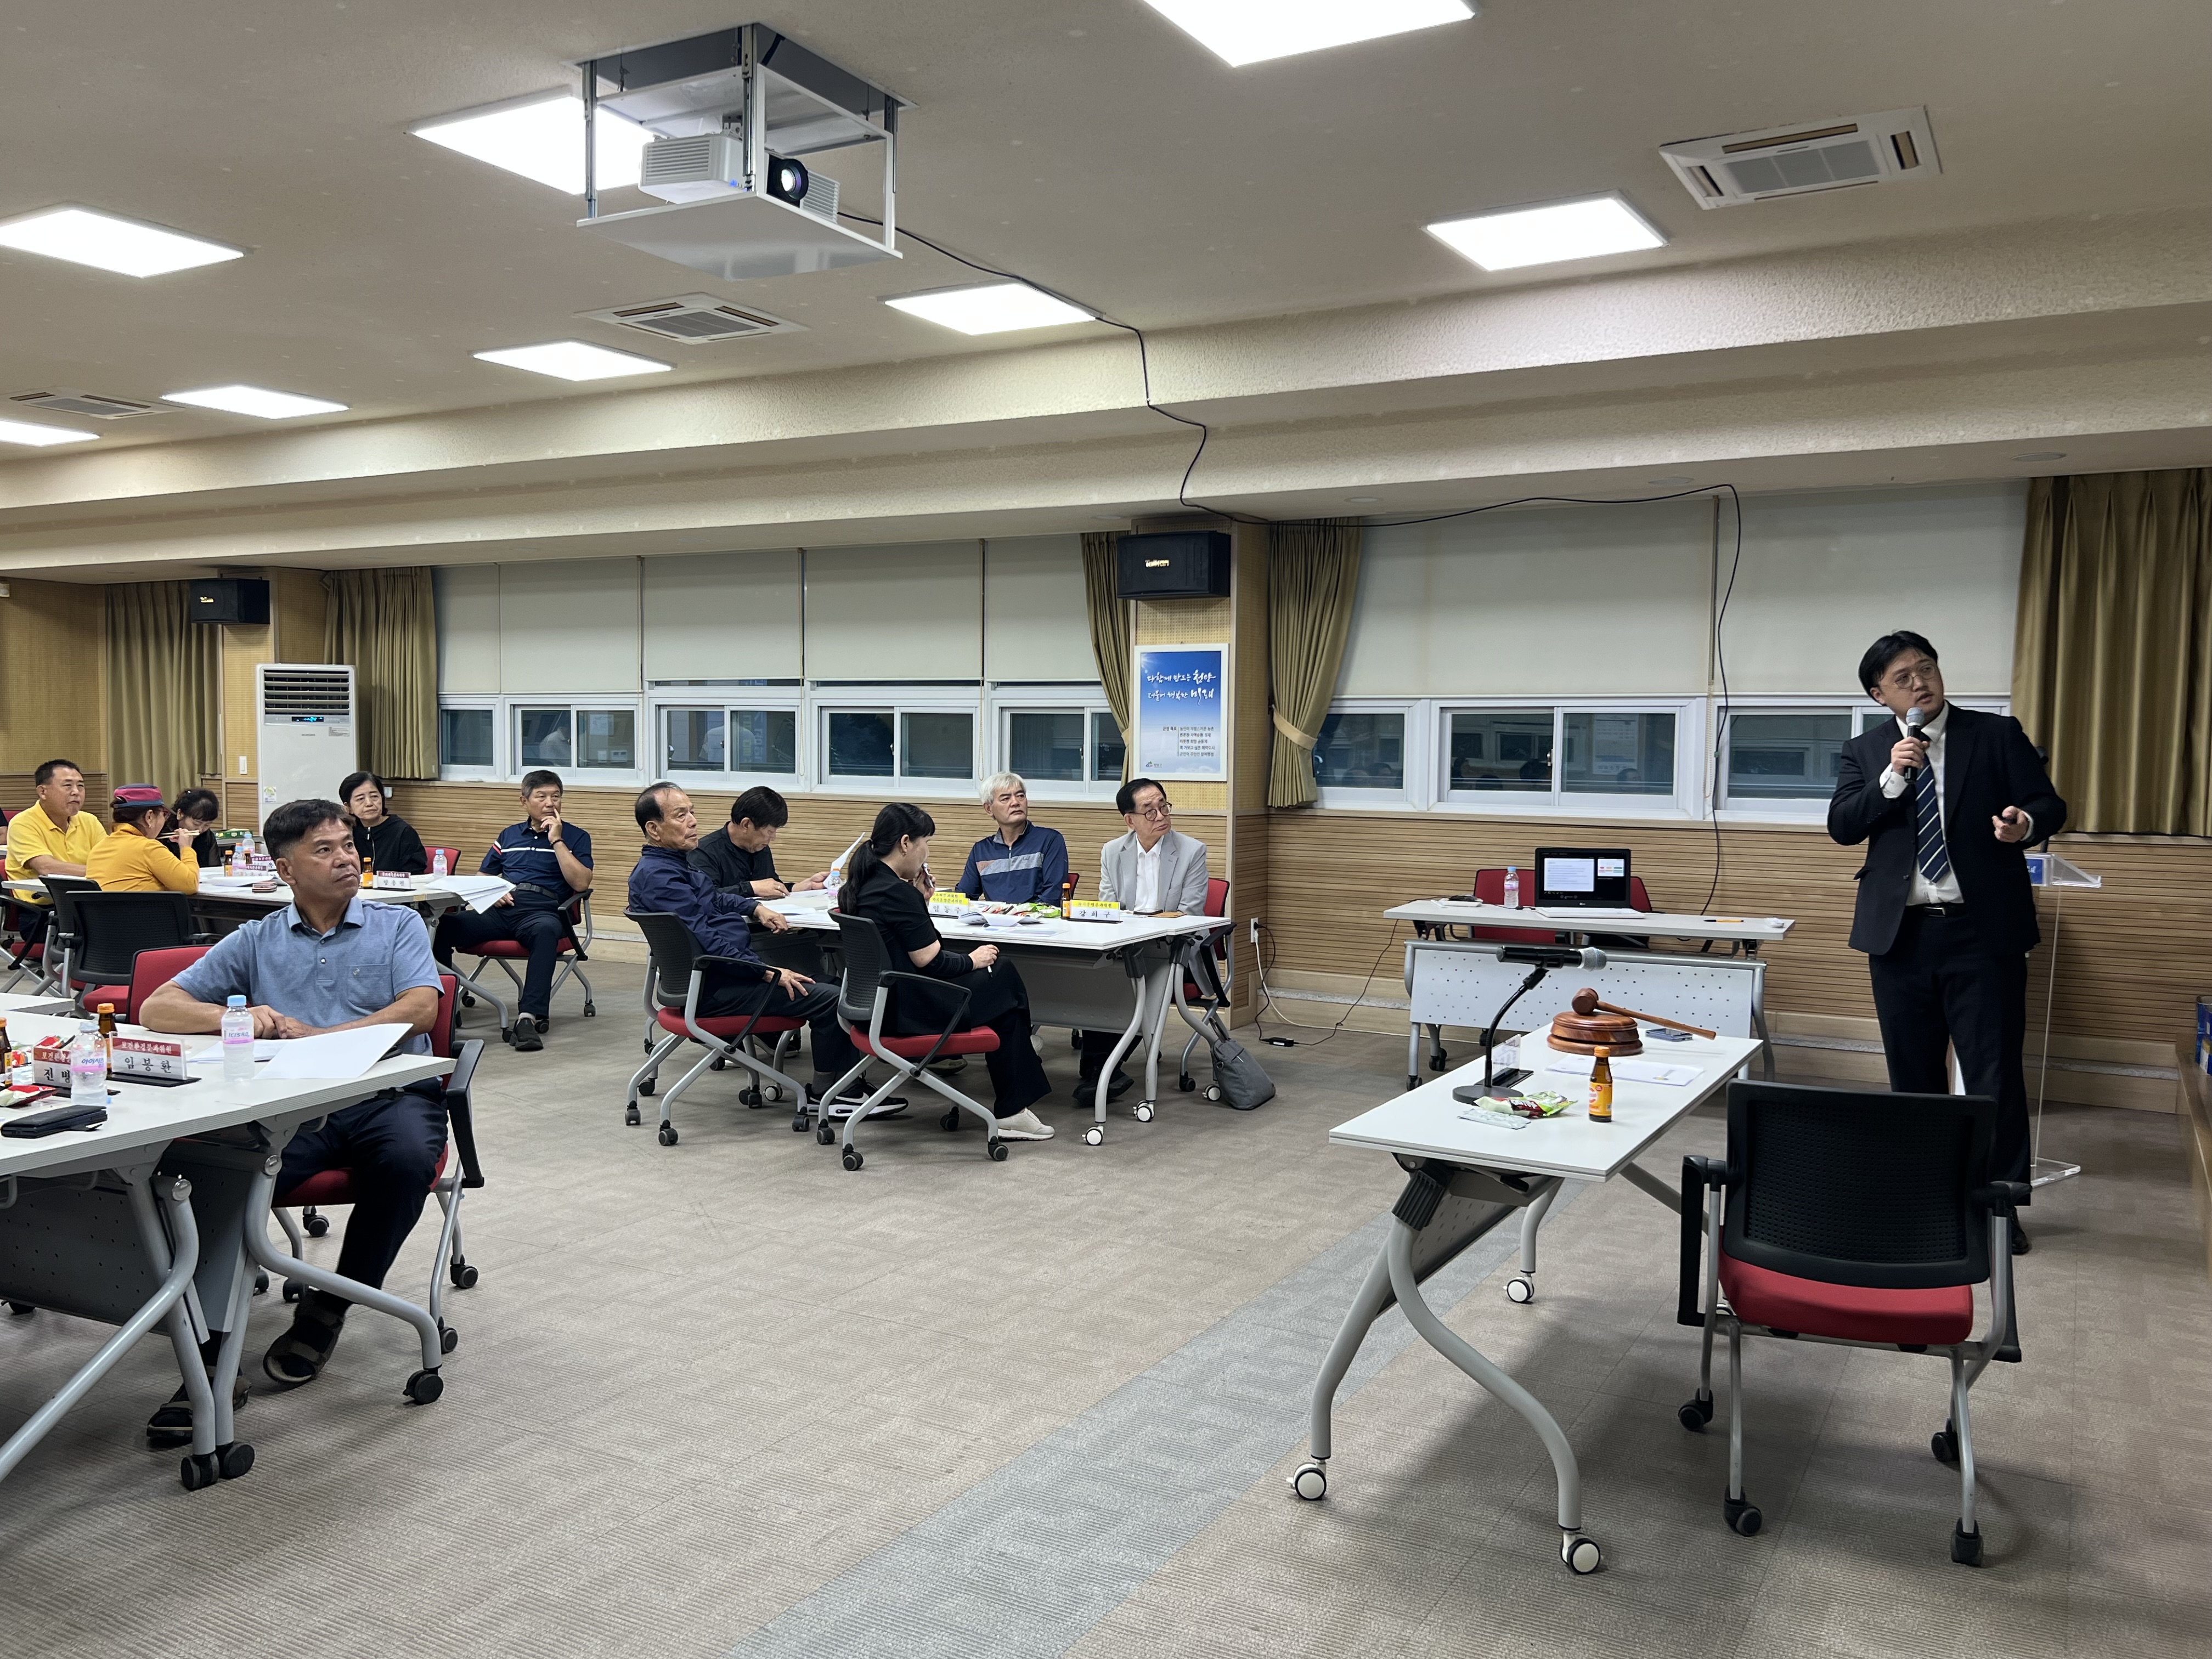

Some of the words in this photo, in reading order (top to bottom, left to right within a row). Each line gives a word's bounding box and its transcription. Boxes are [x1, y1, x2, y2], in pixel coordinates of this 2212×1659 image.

[1147, 672, 1172, 684] 다함께
[1173, 673, 1191, 682] 만드는
[1193, 669, 1216, 685] 청양
[1148, 690, 1165, 702] 더불어
[1167, 690, 1188, 701] 행복한
[1190, 687, 1214, 706] 미래
